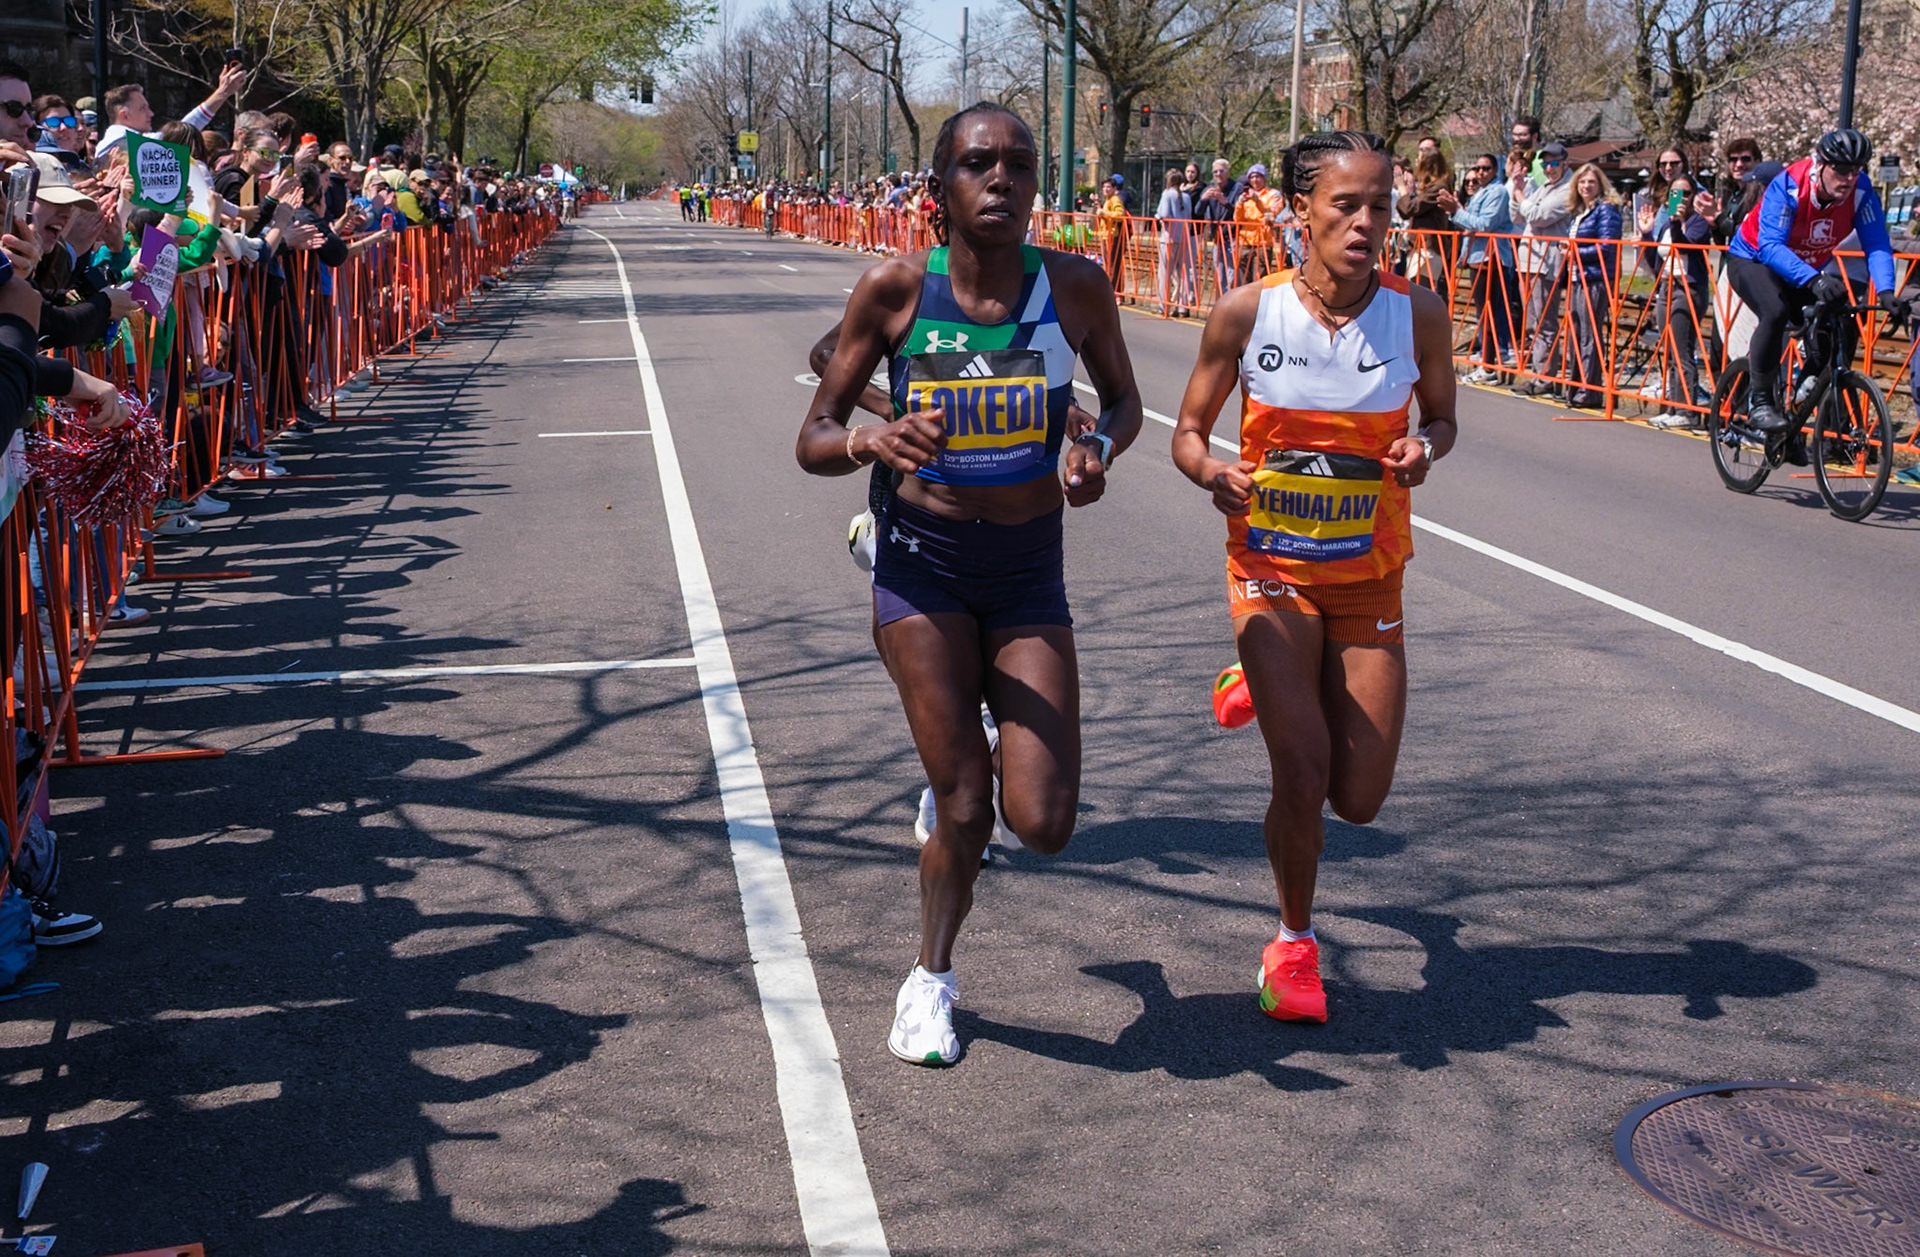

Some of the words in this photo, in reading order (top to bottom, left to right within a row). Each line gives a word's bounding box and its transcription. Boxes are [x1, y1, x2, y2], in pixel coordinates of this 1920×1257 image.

[142, 149, 174, 161] NACHO
[141, 161, 179, 174] AVERAGE
[141, 174, 178, 187] RUNNER!
[1289, 356, 1308, 366] NN
[960, 453, 991, 463] BOSTON
[992, 447, 1032, 461] MARATHON
[1255, 485, 1378, 522] YEHUALAW
[1293, 541, 1321, 551] BOSTON
[1322, 541, 1361, 550] MARATHON
[1742, 1130, 1903, 1228] SEWER
